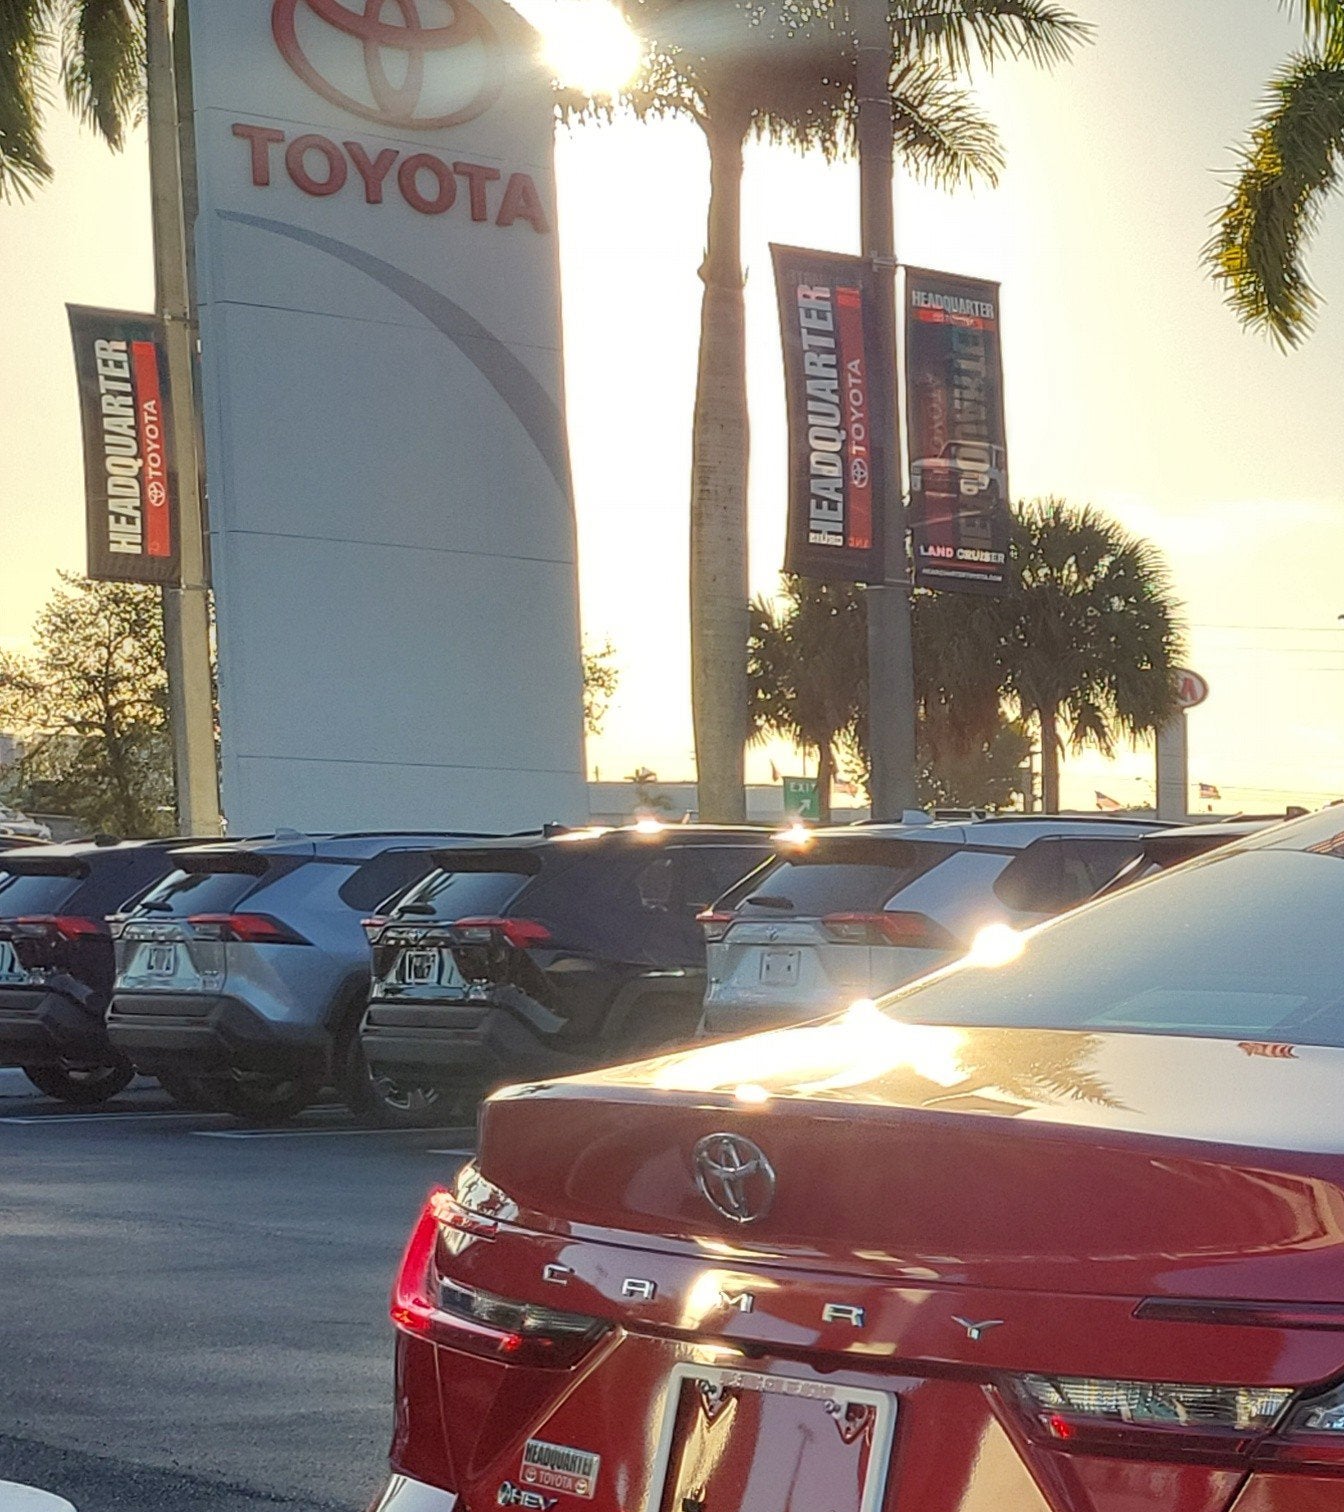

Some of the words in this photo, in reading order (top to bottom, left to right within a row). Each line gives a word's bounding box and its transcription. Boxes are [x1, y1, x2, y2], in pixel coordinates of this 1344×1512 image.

[231, 122, 547, 234] TOYOTA
[911, 289, 994, 319] HEADQUARTER
[143, 399, 162, 479] TOYOTA
[798, 284, 847, 546] HEADQUARTER
[847, 358, 867, 454] TOYOTA
[95, 339, 143, 555] HEADQUARTER
[919, 544, 954, 559] LAND
[956, 548, 1005, 564] CRUISER
[541, 1263, 1004, 1340] CAMRY
[525, 1442, 593, 1477] HEADQUARTER
[539, 1470, 573, 1490] TOYOTA
[510, 1487, 558, 1511] HEV
